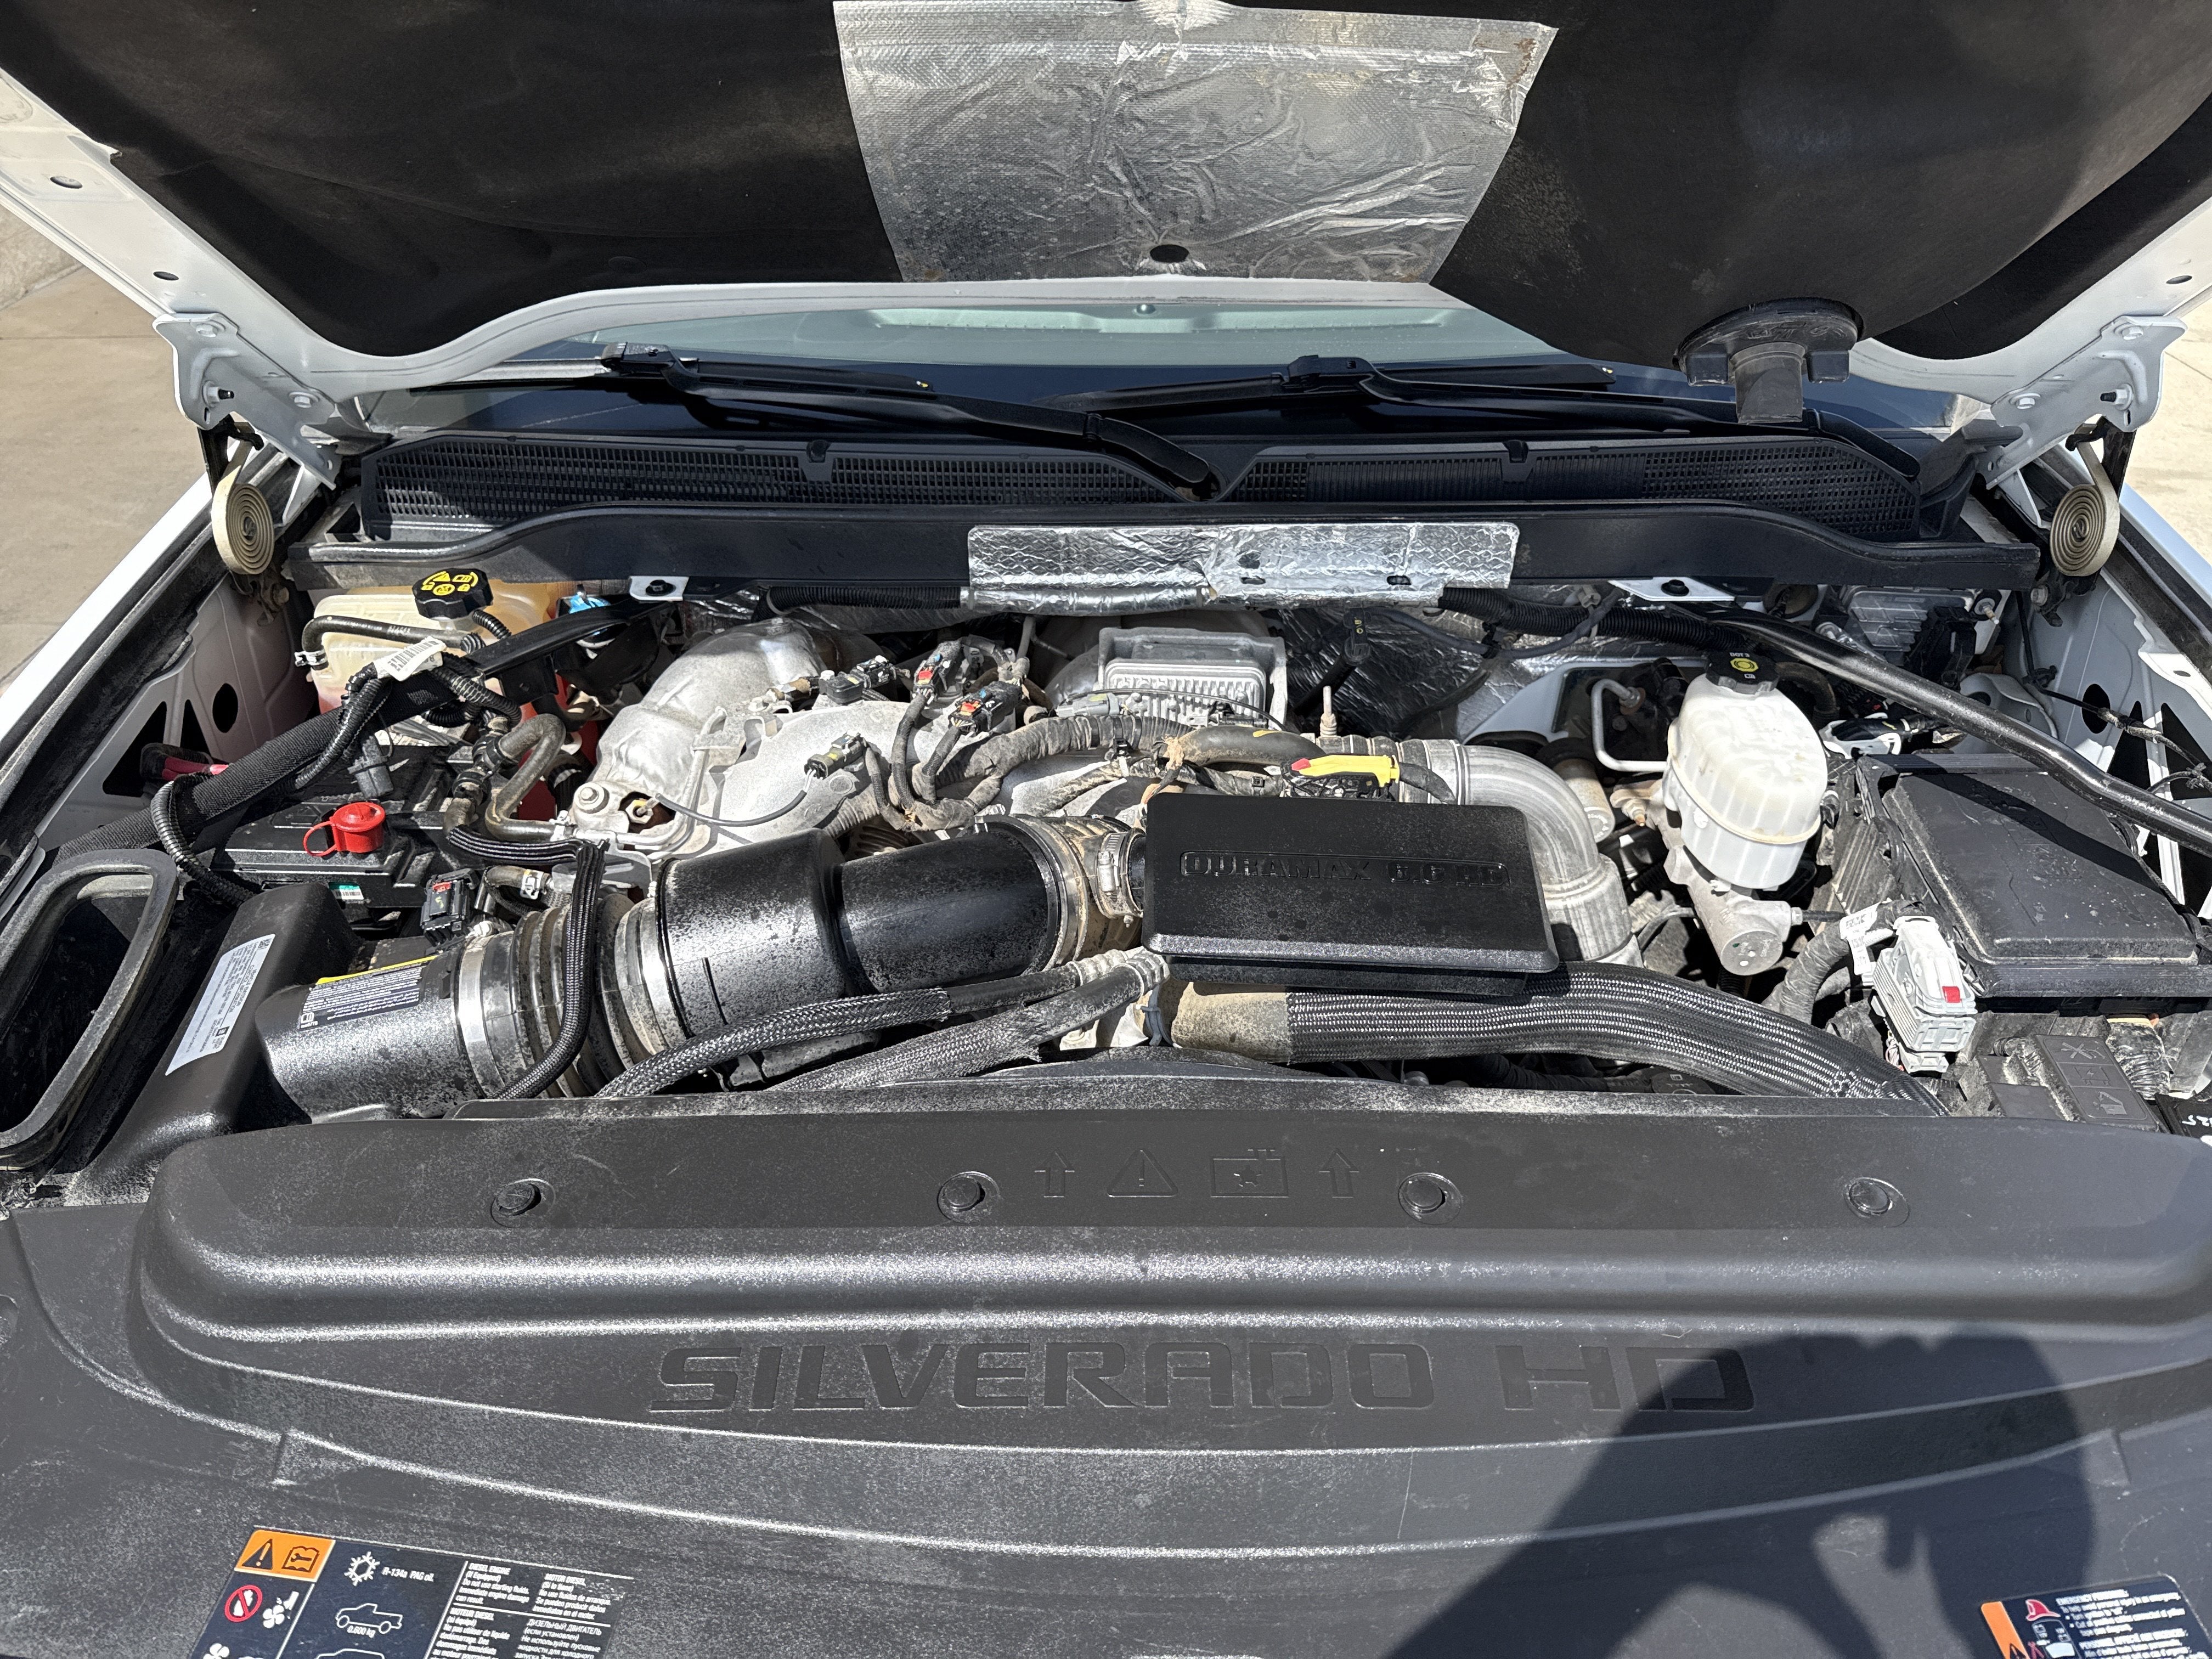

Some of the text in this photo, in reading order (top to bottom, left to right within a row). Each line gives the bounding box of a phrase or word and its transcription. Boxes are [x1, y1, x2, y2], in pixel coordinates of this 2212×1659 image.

[1181, 852, 1372, 881] DURAMAX
[1454, 864, 1510, 887] HD
[649, 1342, 1754, 1412] SILVERADO HD
[409, 1570, 425, 1580] PAG
[469, 1563, 511, 1575] DIESEL ENGINE
[545, 1573, 585, 1585] MOTOR DIESEL
[492, 1583, 512, 1593] starting
[507, 1594, 529, 1603] damage
[475, 1611, 494, 1621] DIESEL
[347, 1625, 376, 1638] 0.600 kg
[527, 1619, 602, 1635] ДИЗЕЛЬНЫЙ ДВИГАТЕЛЬ
[541, 1630, 579, 1641] установлен)
[531, 1638, 569, 1648] используйте
[571, 1643, 600, 1652] пусковые
